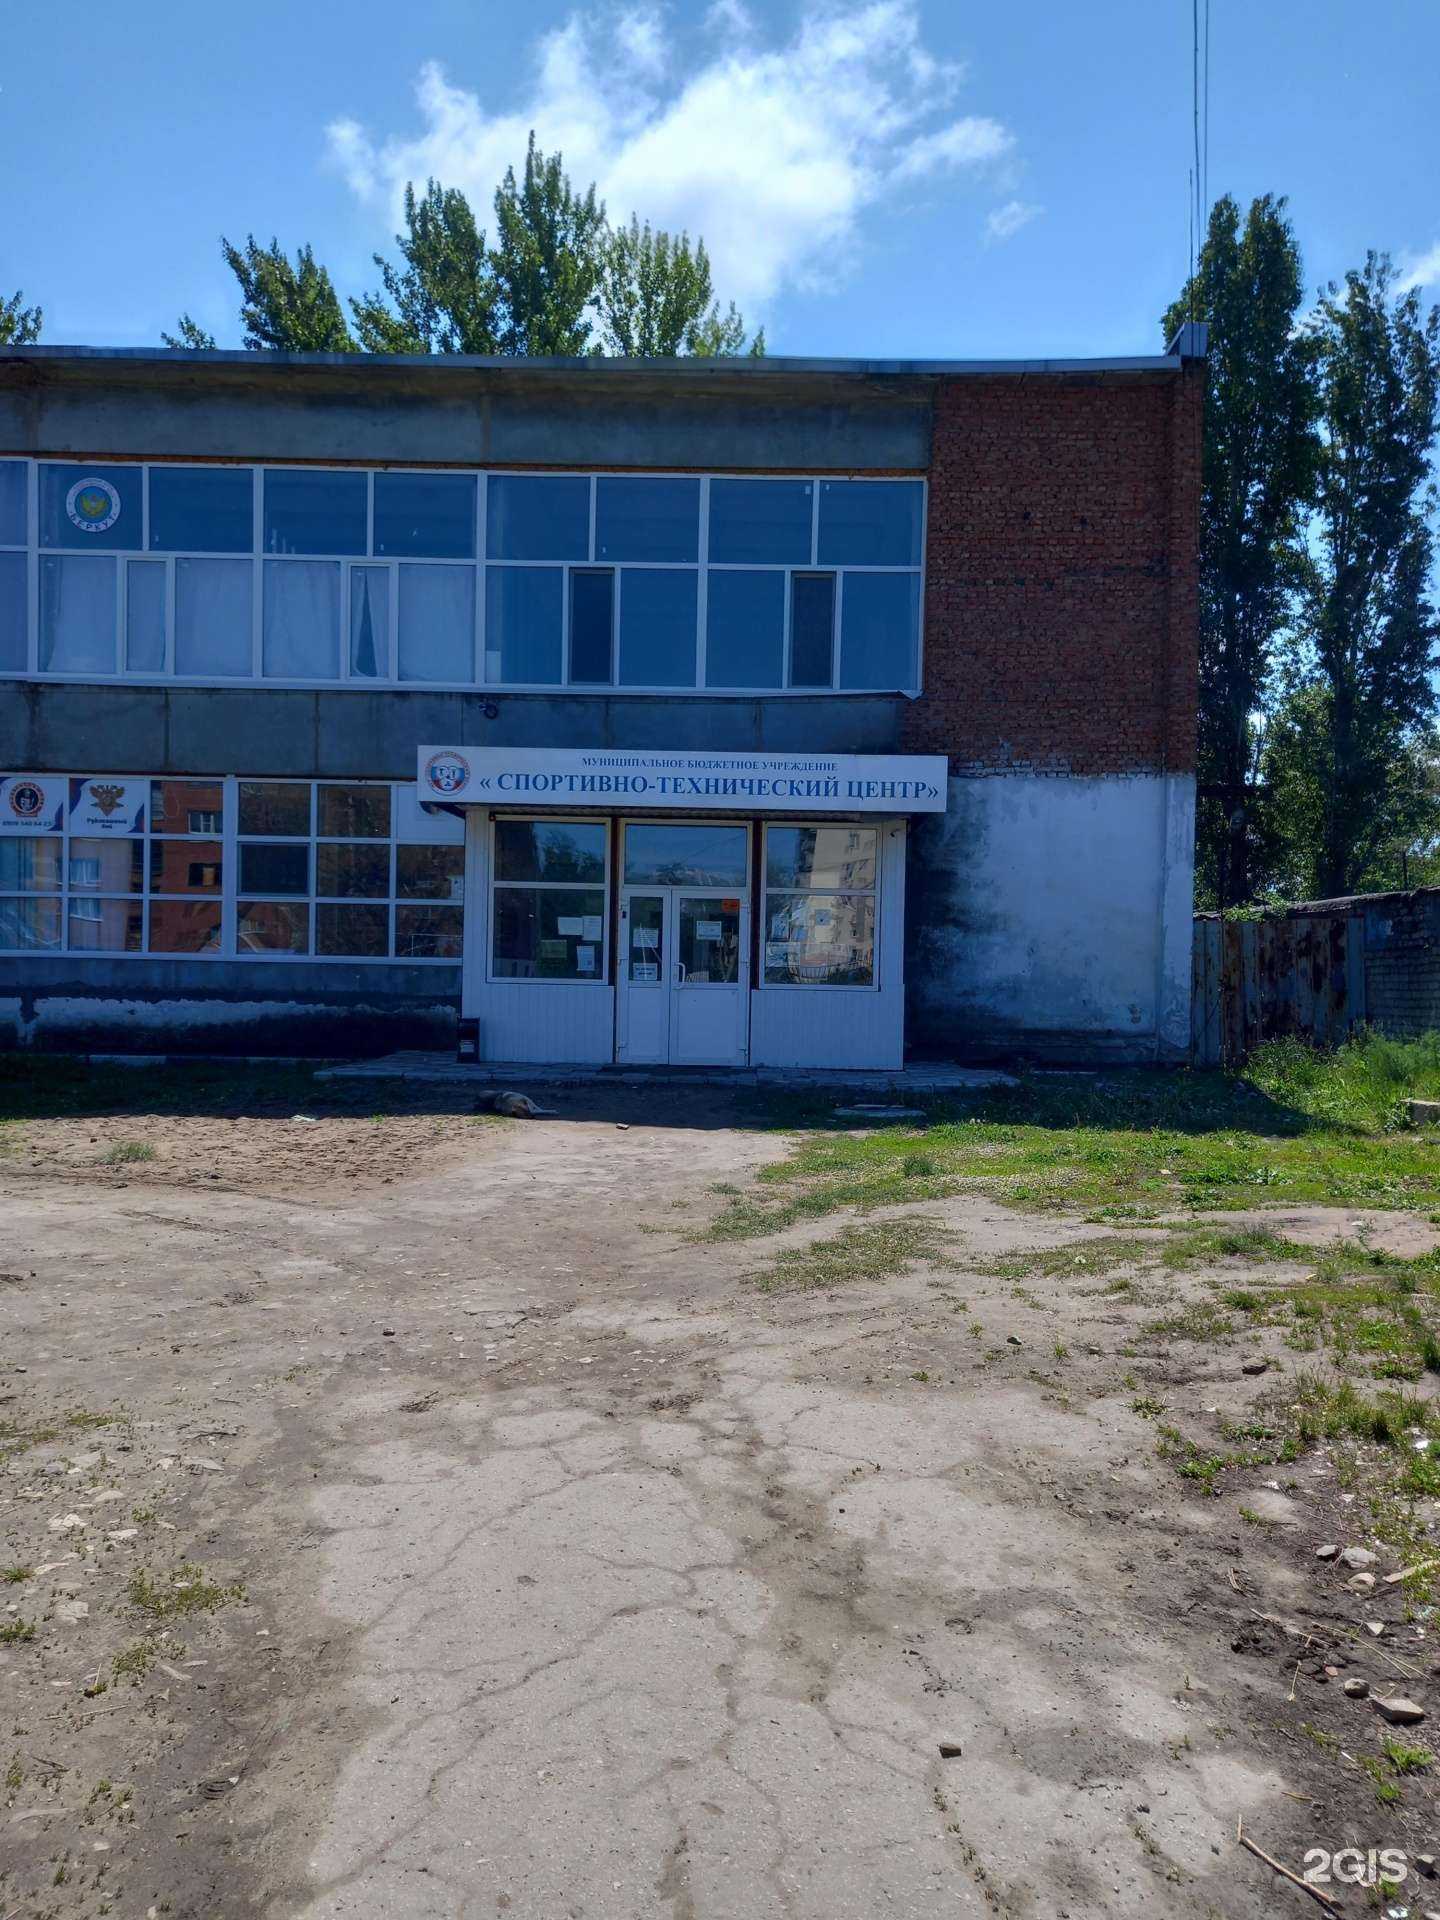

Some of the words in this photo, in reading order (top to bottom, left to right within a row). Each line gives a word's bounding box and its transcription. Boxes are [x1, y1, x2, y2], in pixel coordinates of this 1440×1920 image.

[582, 757, 685, 769] МУНИЦИПАЛЬНОЕ
[687, 758, 759, 770] БЮДЖЕТНОЕ
[762, 761, 838, 772] УЧРЕЖДЕНИЕ
[847, 780, 939, 801] ЦЕНТР»
